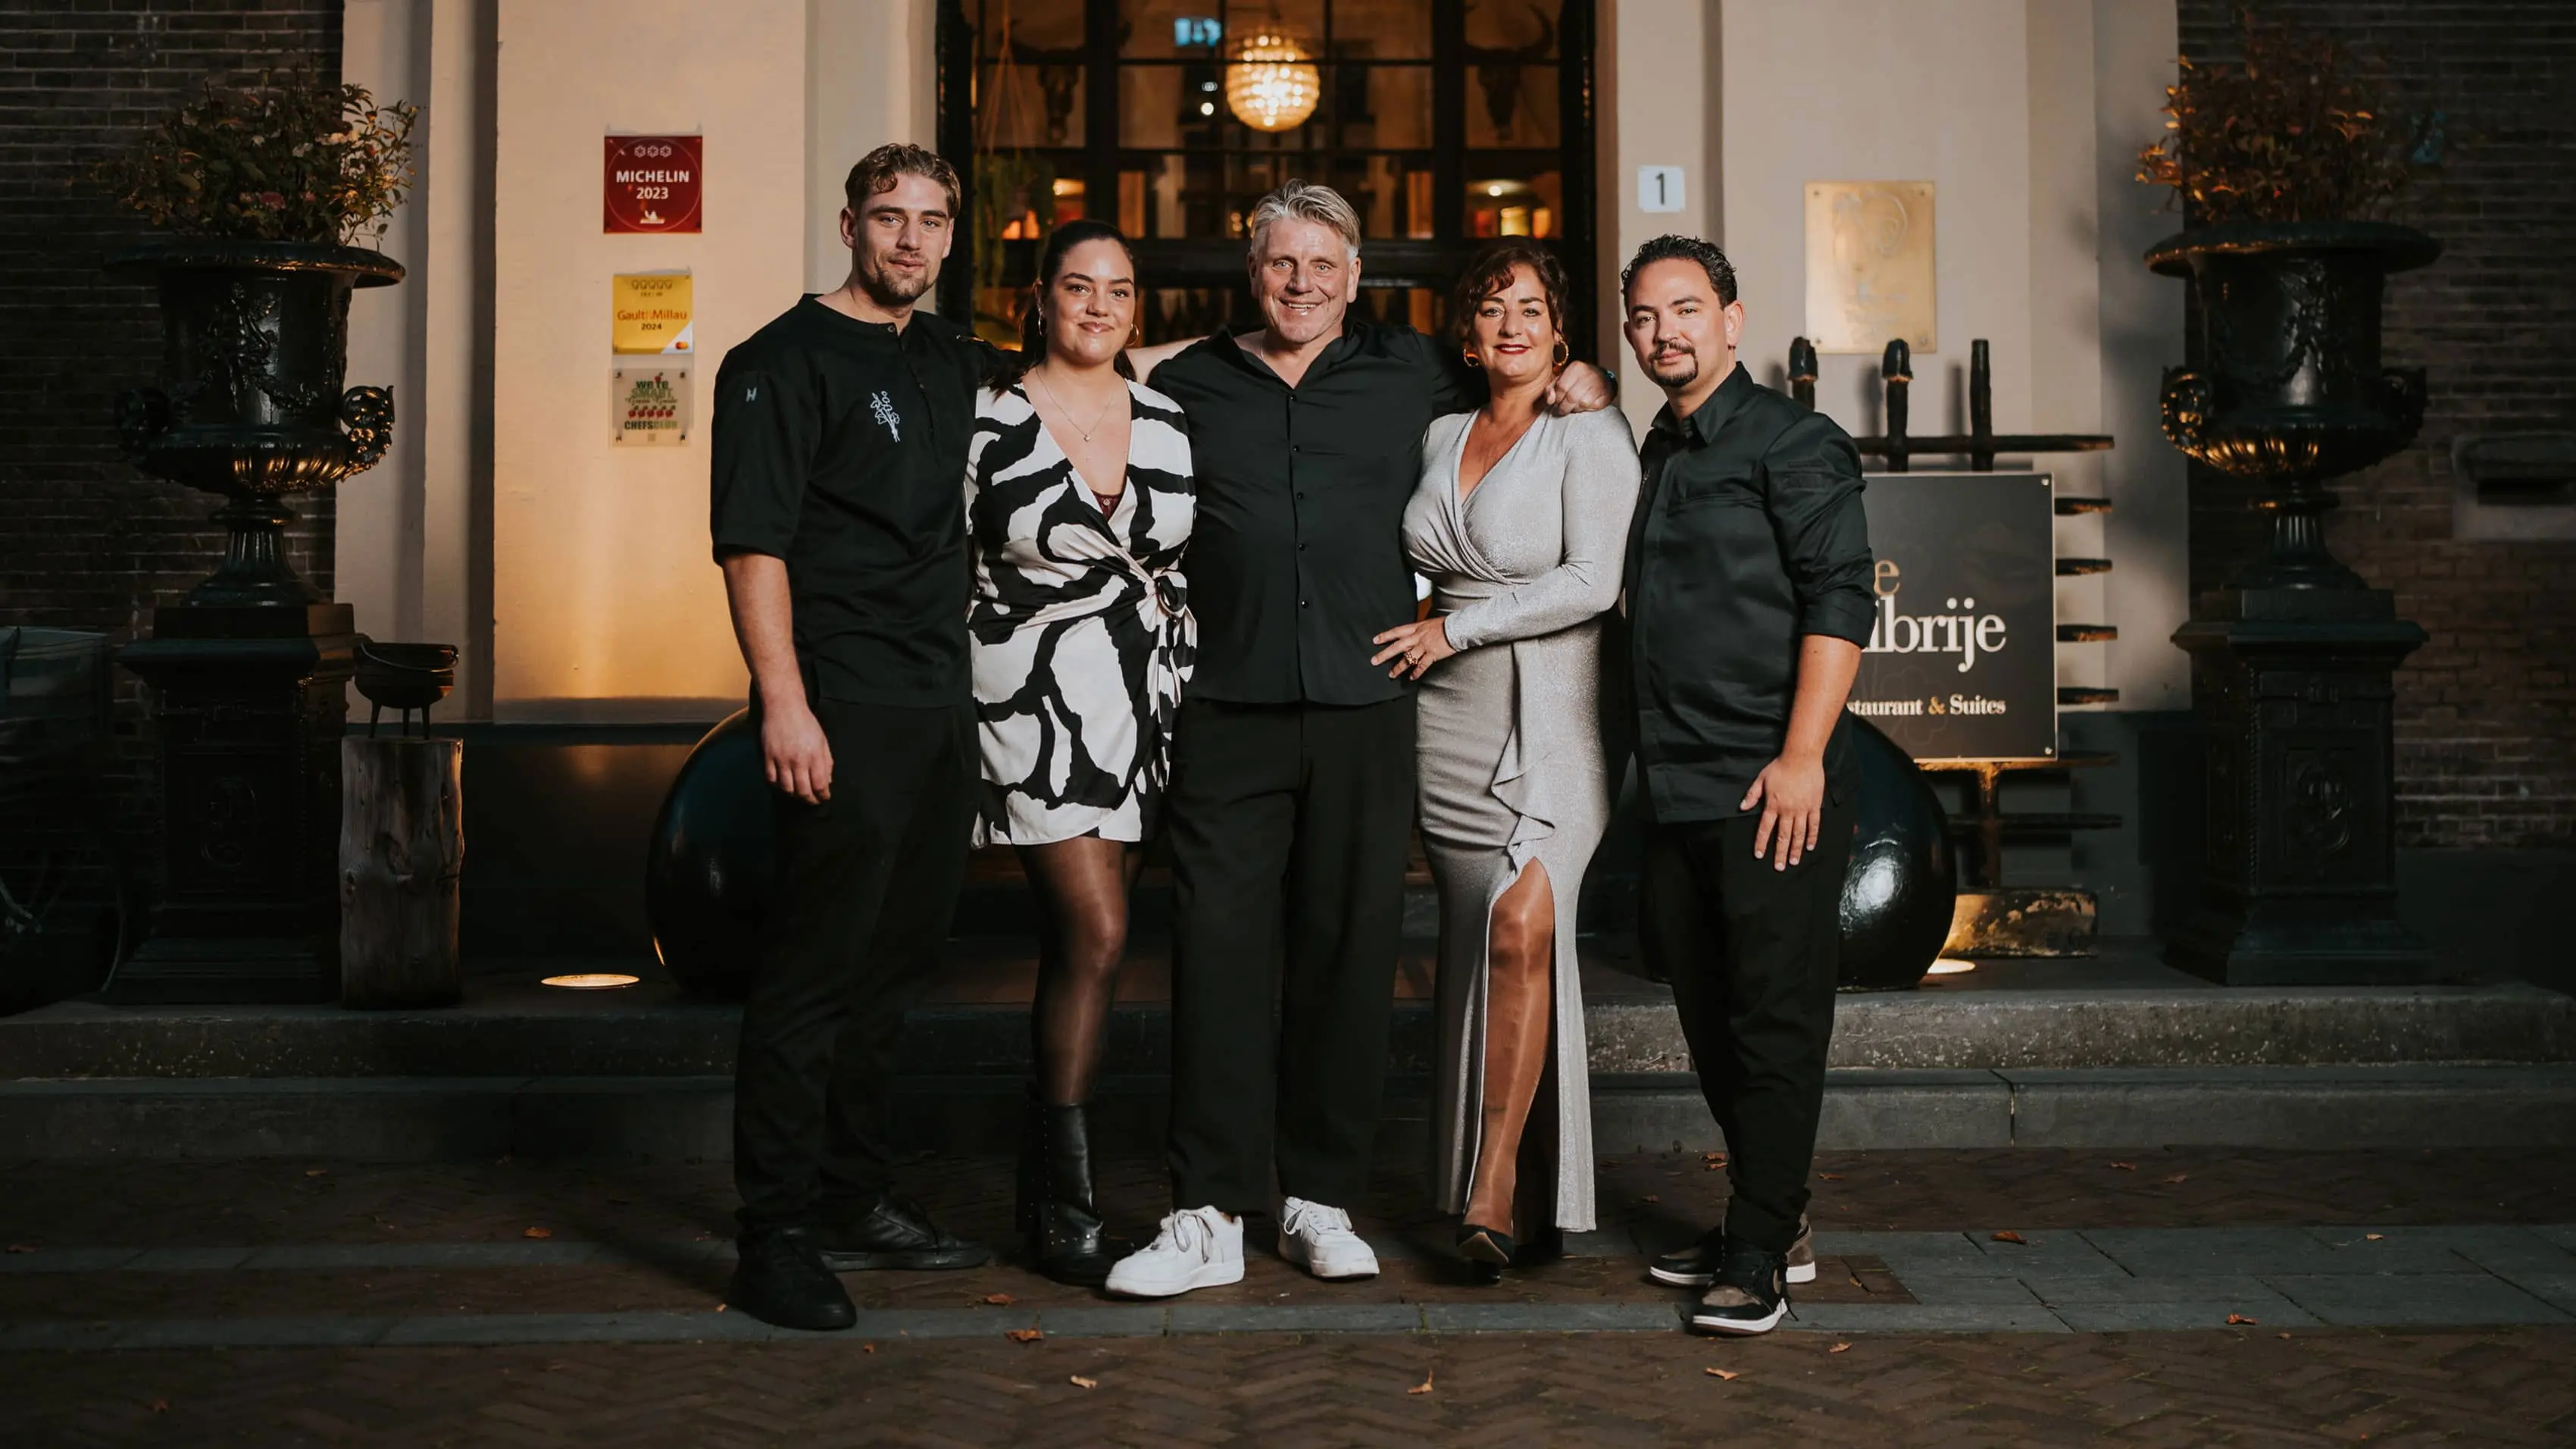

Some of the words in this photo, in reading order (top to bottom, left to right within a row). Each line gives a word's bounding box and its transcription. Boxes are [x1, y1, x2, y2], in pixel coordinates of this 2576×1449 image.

[616, 170, 689, 183] MICHELIN
[636, 186, 669, 199] 2023
[1655, 172, 1665, 205] 1
[641, 323, 662, 331] 2024
[1874, 559, 1901, 596] e
[1862, 593, 2007, 673] ibrije
[1846, 698, 1924, 716] staurant
[1927, 696, 1946, 715] &
[1949, 693, 2007, 715] Suites
